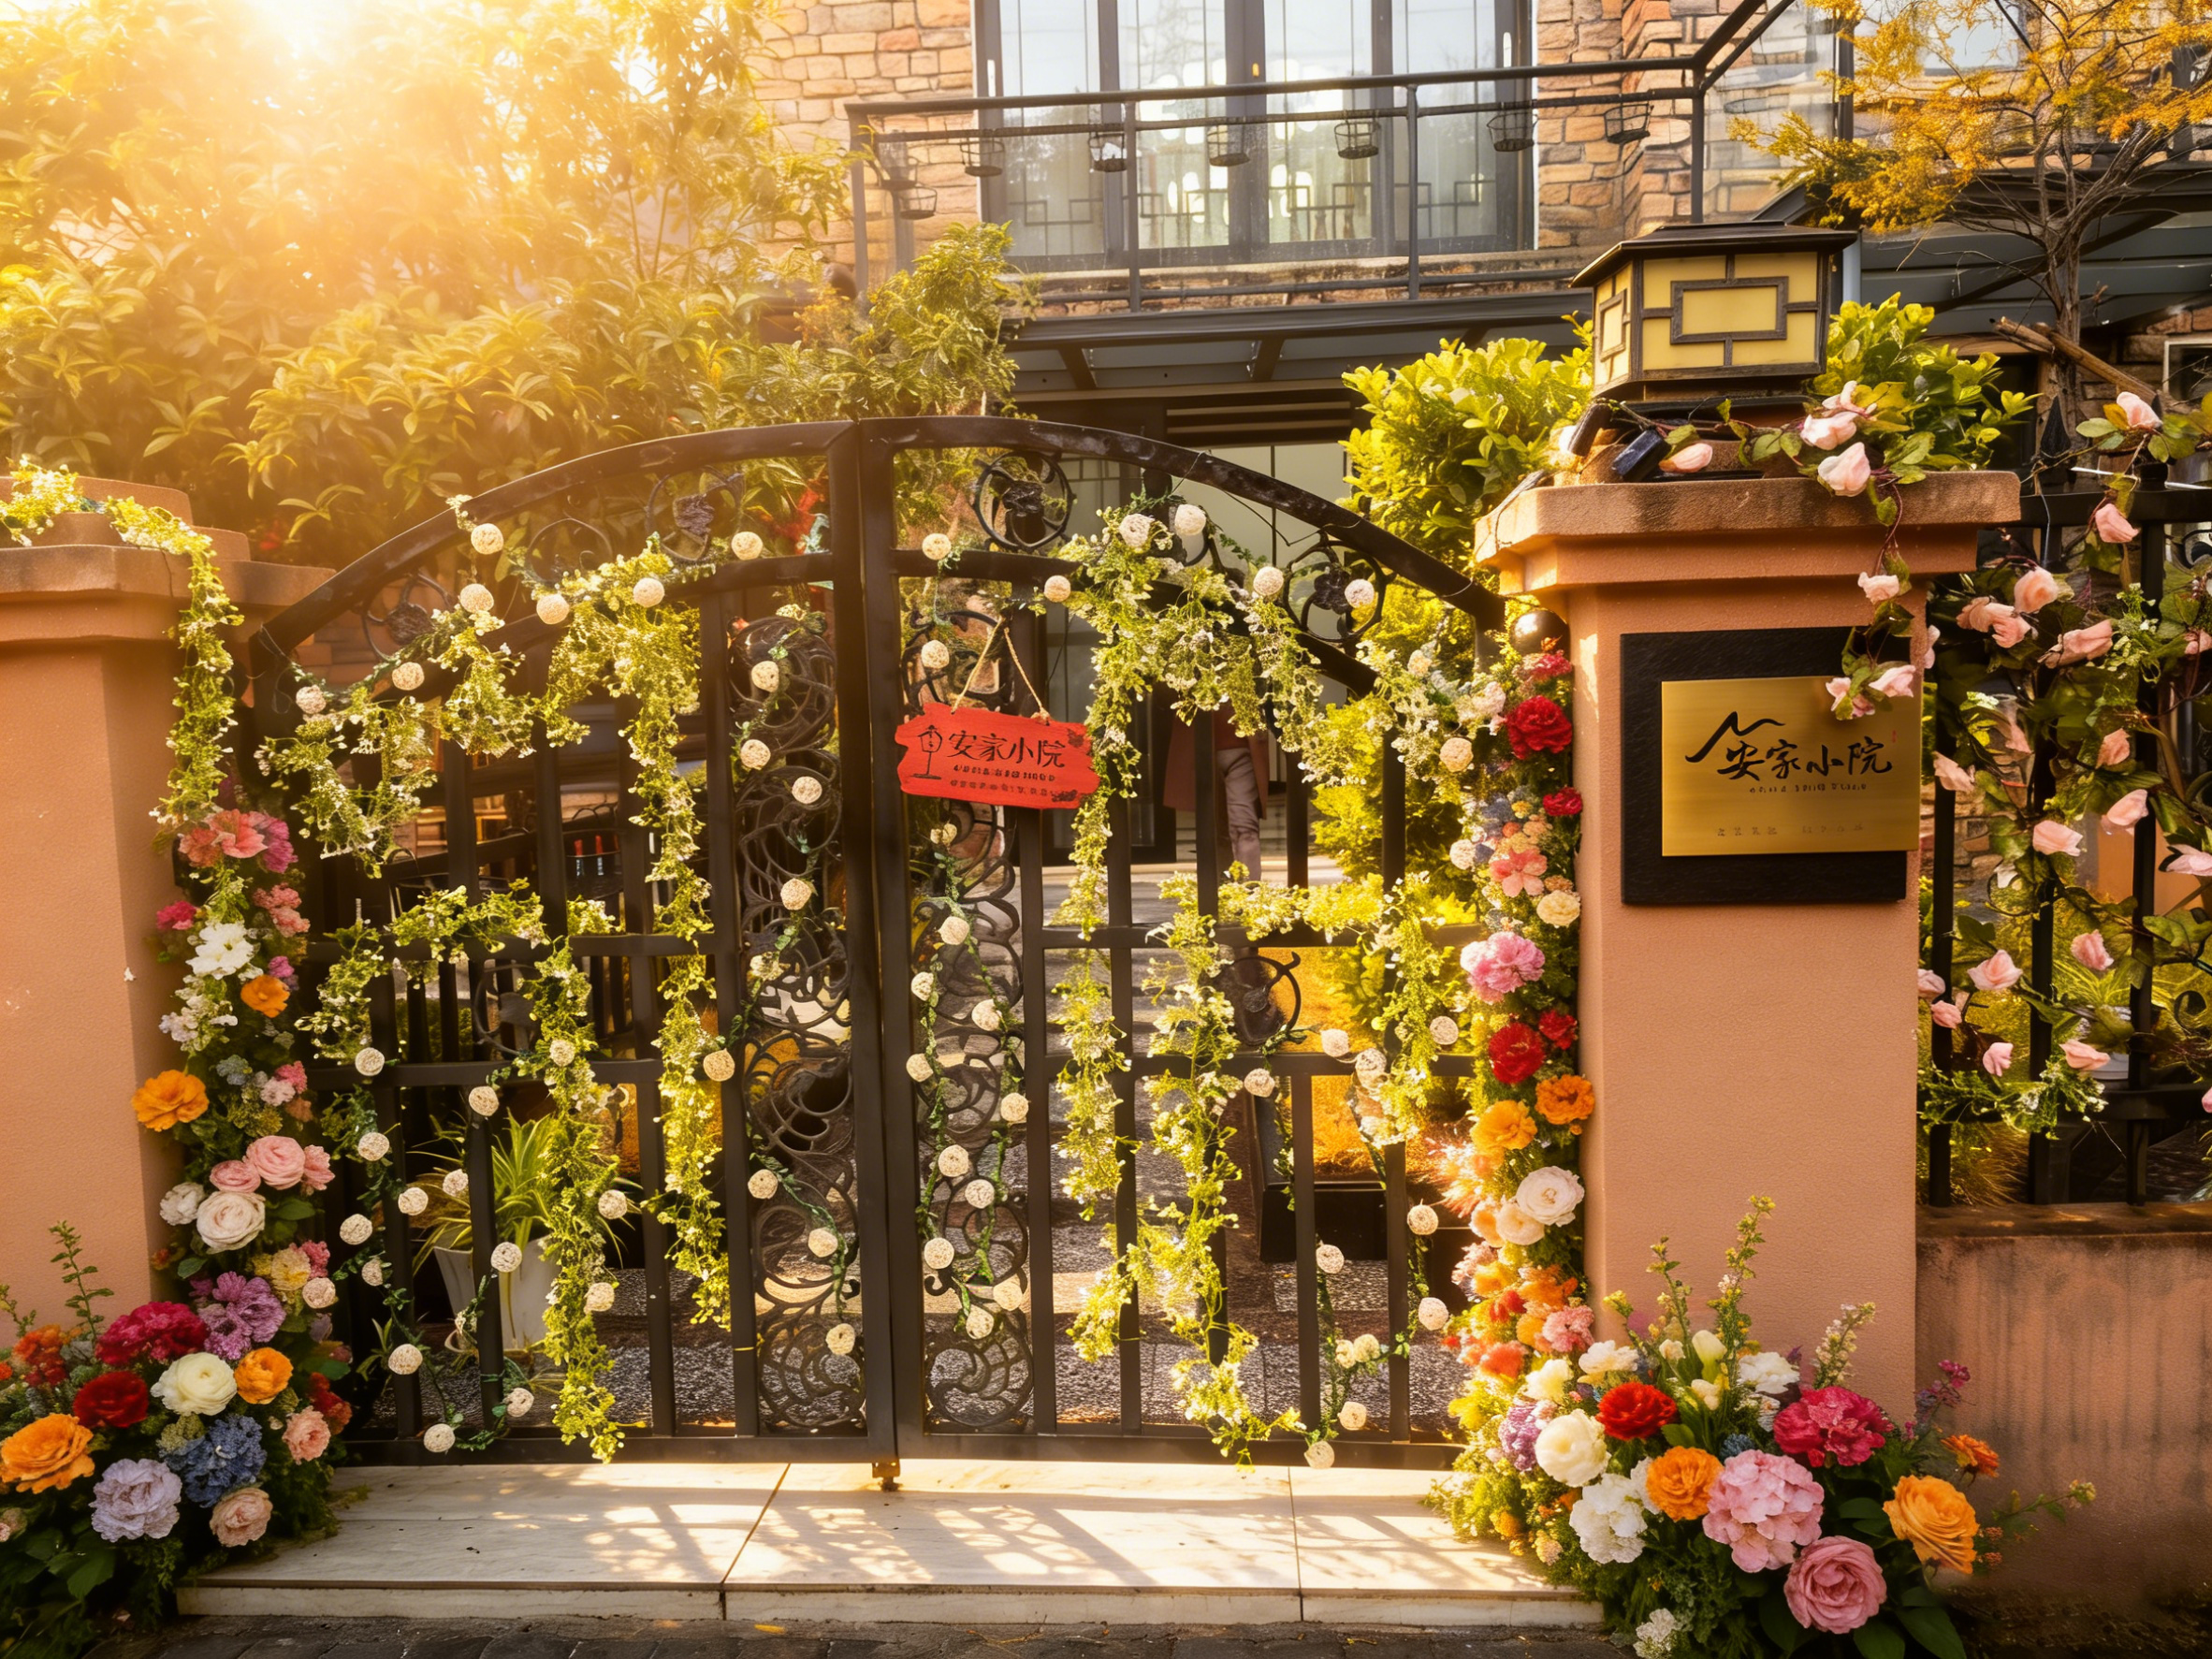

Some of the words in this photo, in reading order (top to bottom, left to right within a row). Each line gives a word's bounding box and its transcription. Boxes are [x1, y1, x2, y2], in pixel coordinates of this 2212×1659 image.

[947, 730, 1066, 768] 安家小院
[1717, 735, 1893, 781] 安家小院
